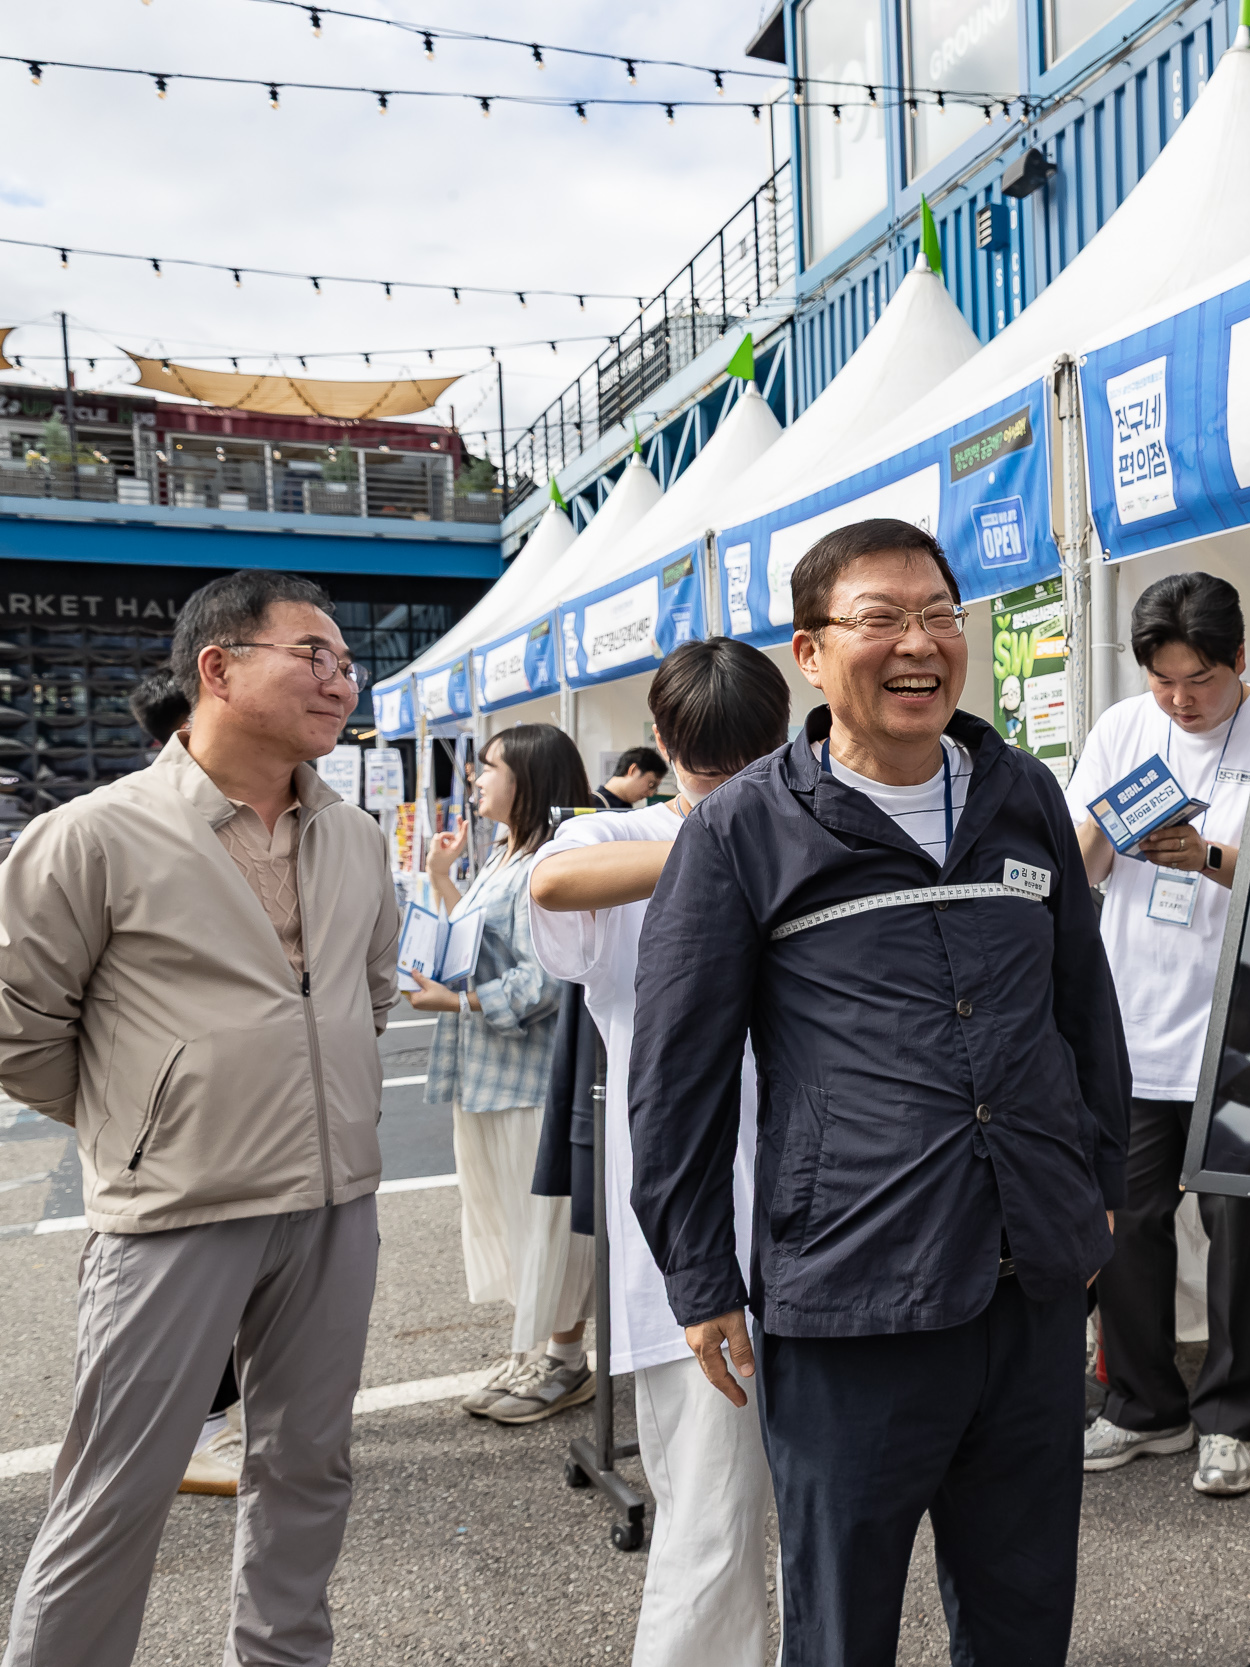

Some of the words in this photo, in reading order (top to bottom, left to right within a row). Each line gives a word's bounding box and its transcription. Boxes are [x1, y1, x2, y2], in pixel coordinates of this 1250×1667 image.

[1115, 393, 1161, 443] 진구네
[1118, 440, 1167, 488] 편의점
[983, 522, 1022, 559] OPEN
